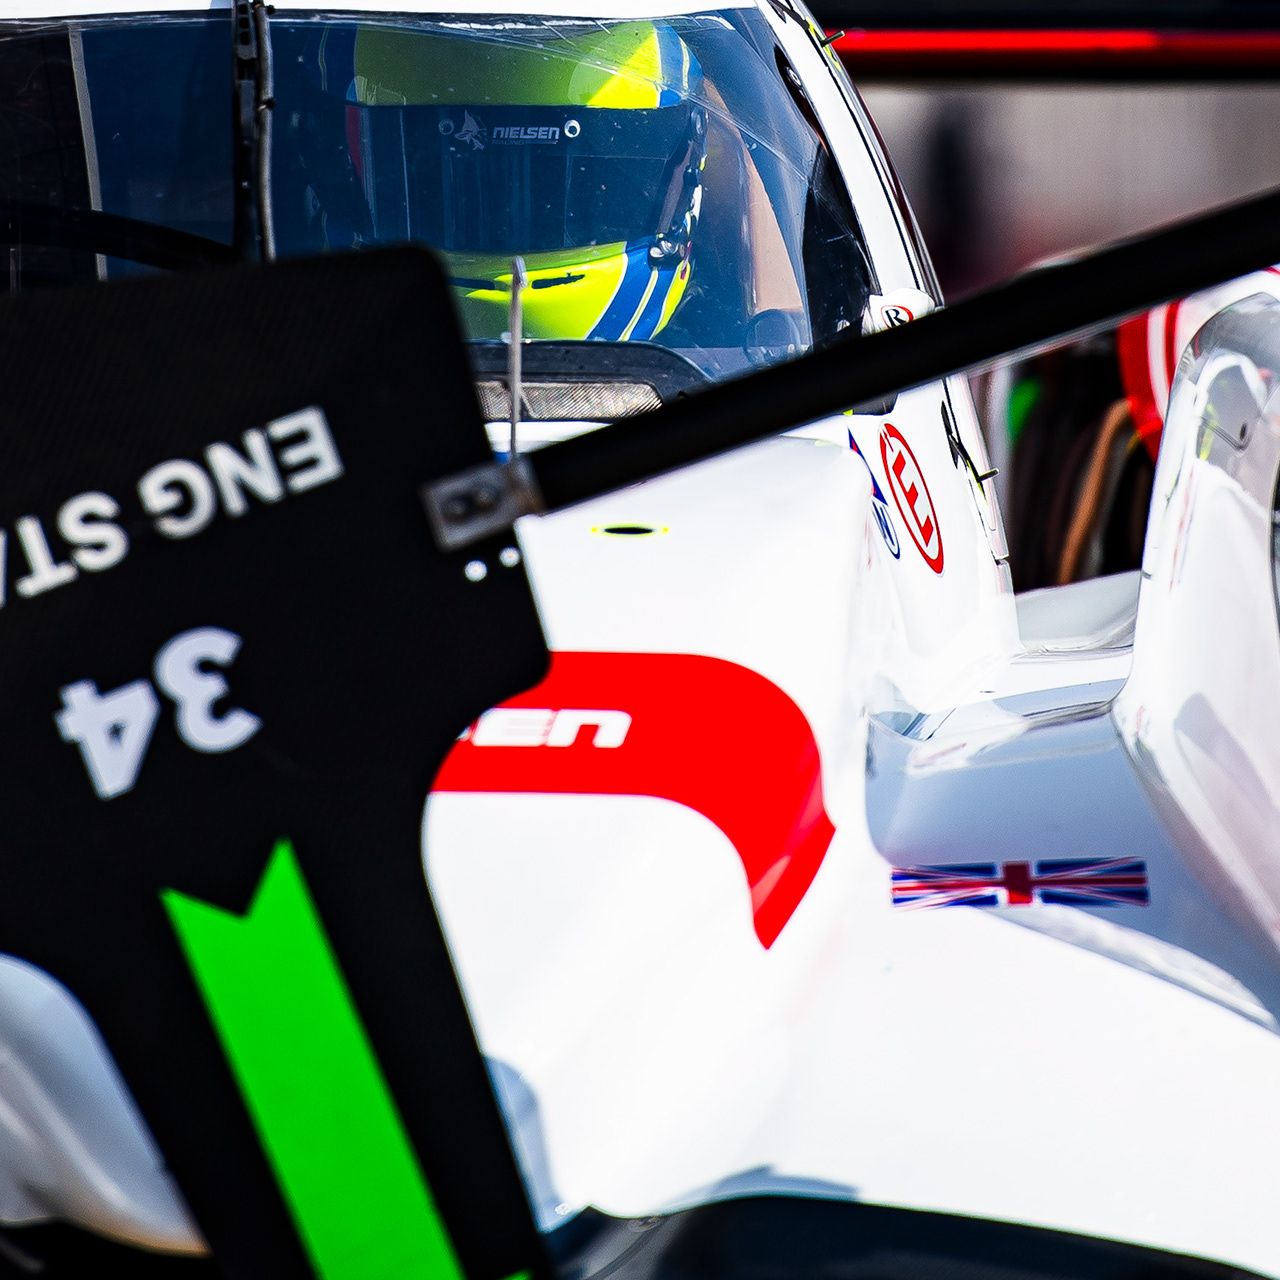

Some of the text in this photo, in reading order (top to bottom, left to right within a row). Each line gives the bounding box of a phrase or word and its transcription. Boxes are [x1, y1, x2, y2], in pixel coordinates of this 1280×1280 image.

[492, 126, 560, 140] NIELSEN
[138, 406, 344, 539] ENG
[55, 626, 260, 799] 34
